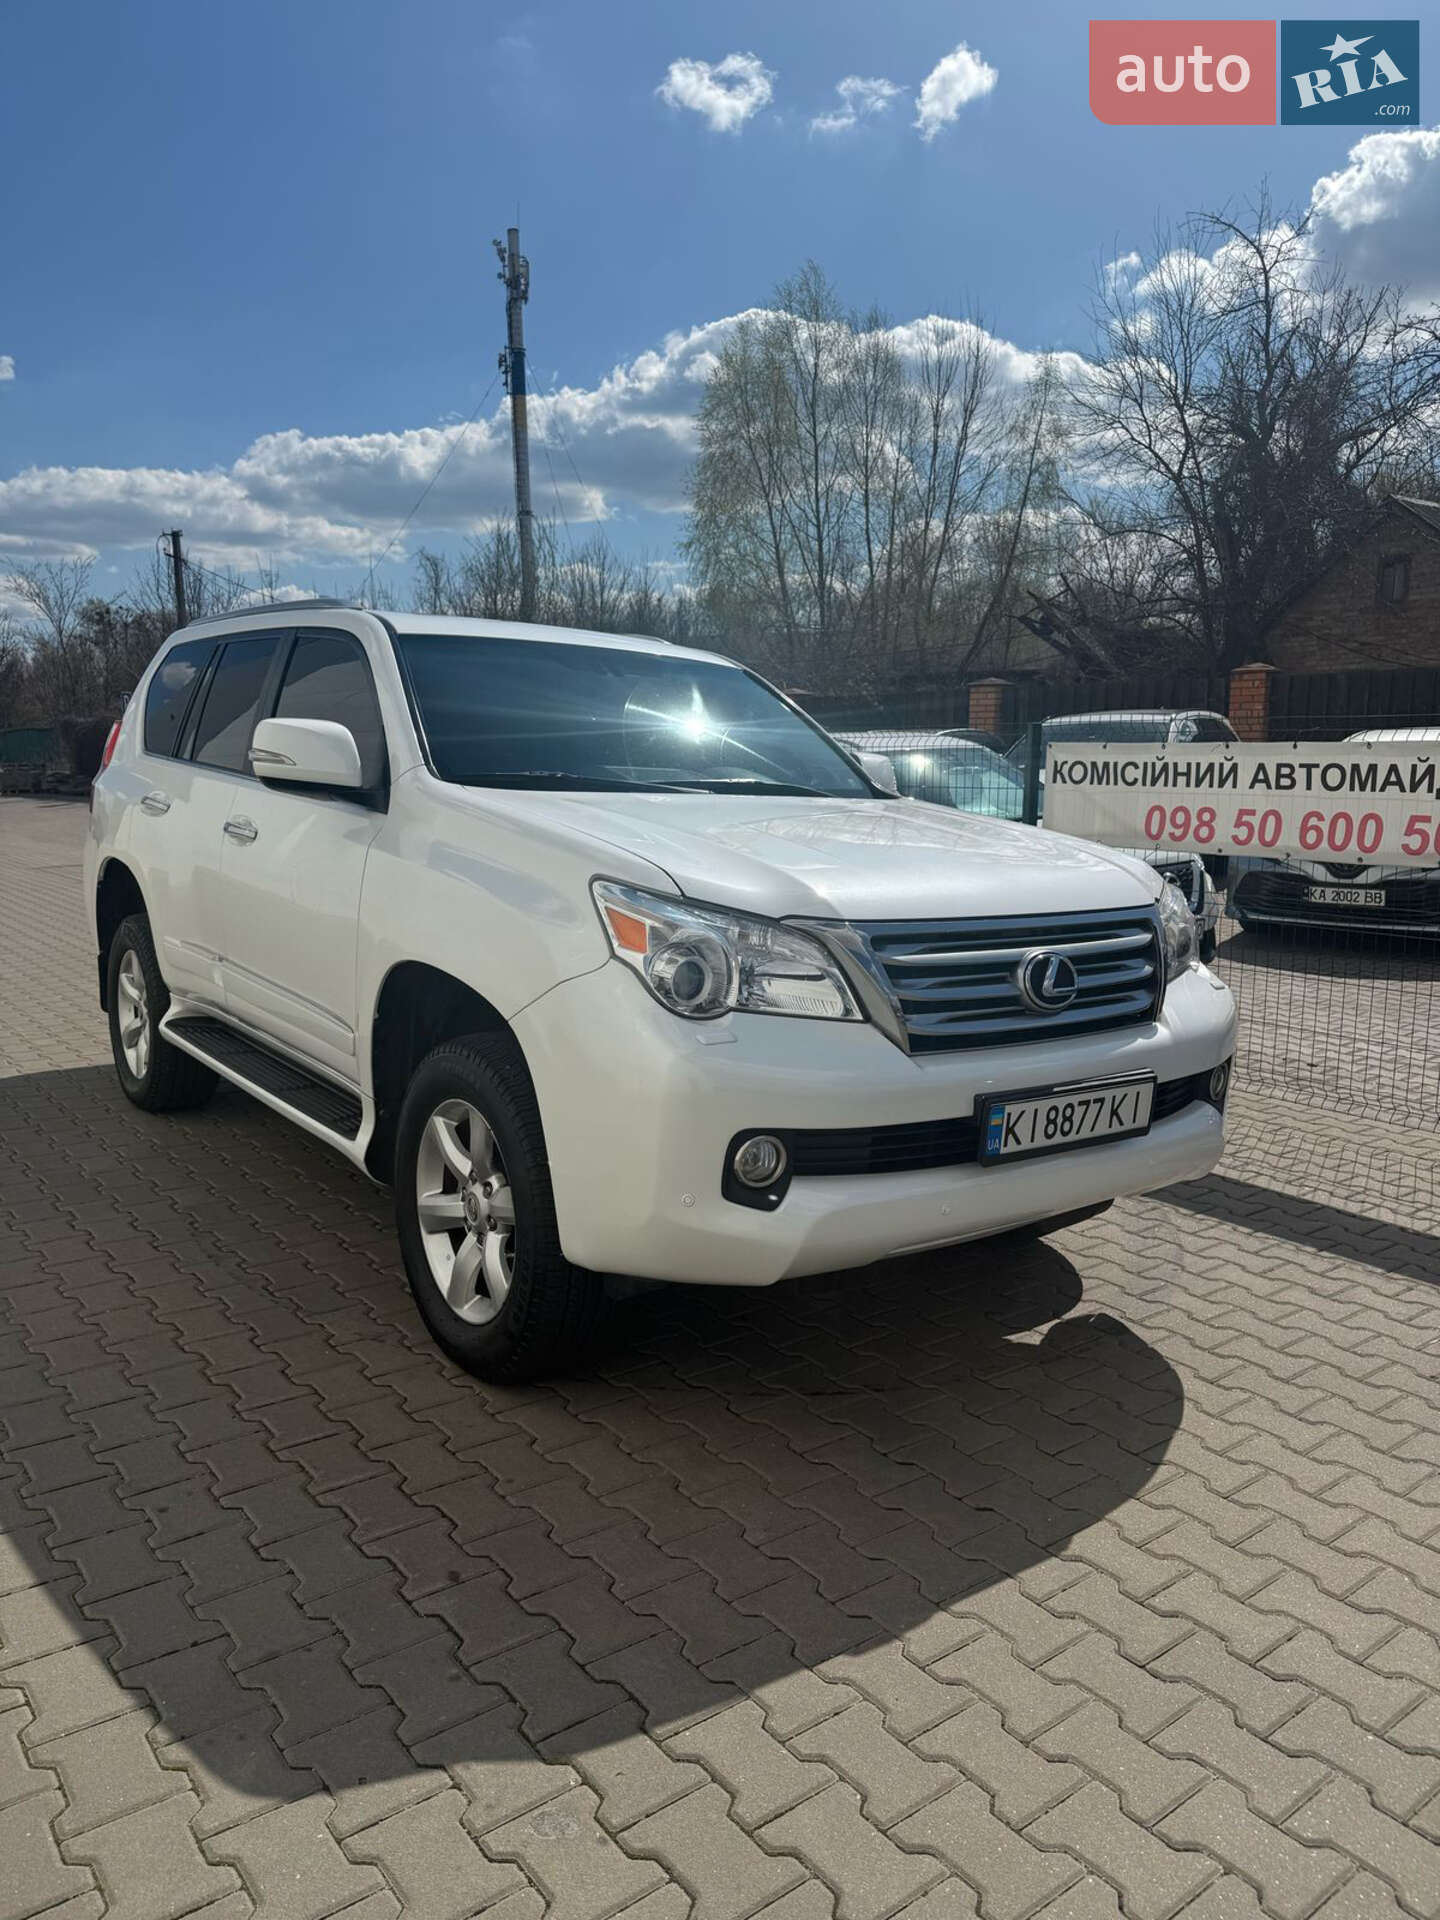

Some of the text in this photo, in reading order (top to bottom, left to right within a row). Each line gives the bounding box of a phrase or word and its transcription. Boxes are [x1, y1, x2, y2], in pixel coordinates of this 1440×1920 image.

[1052, 756, 1440, 800] КОМІСІЙНИЙ АВТОМАЙ
[1144, 805, 1440, 857] 098 50 600 5
[1309, 889, 1383, 904] KA 2002 BB
